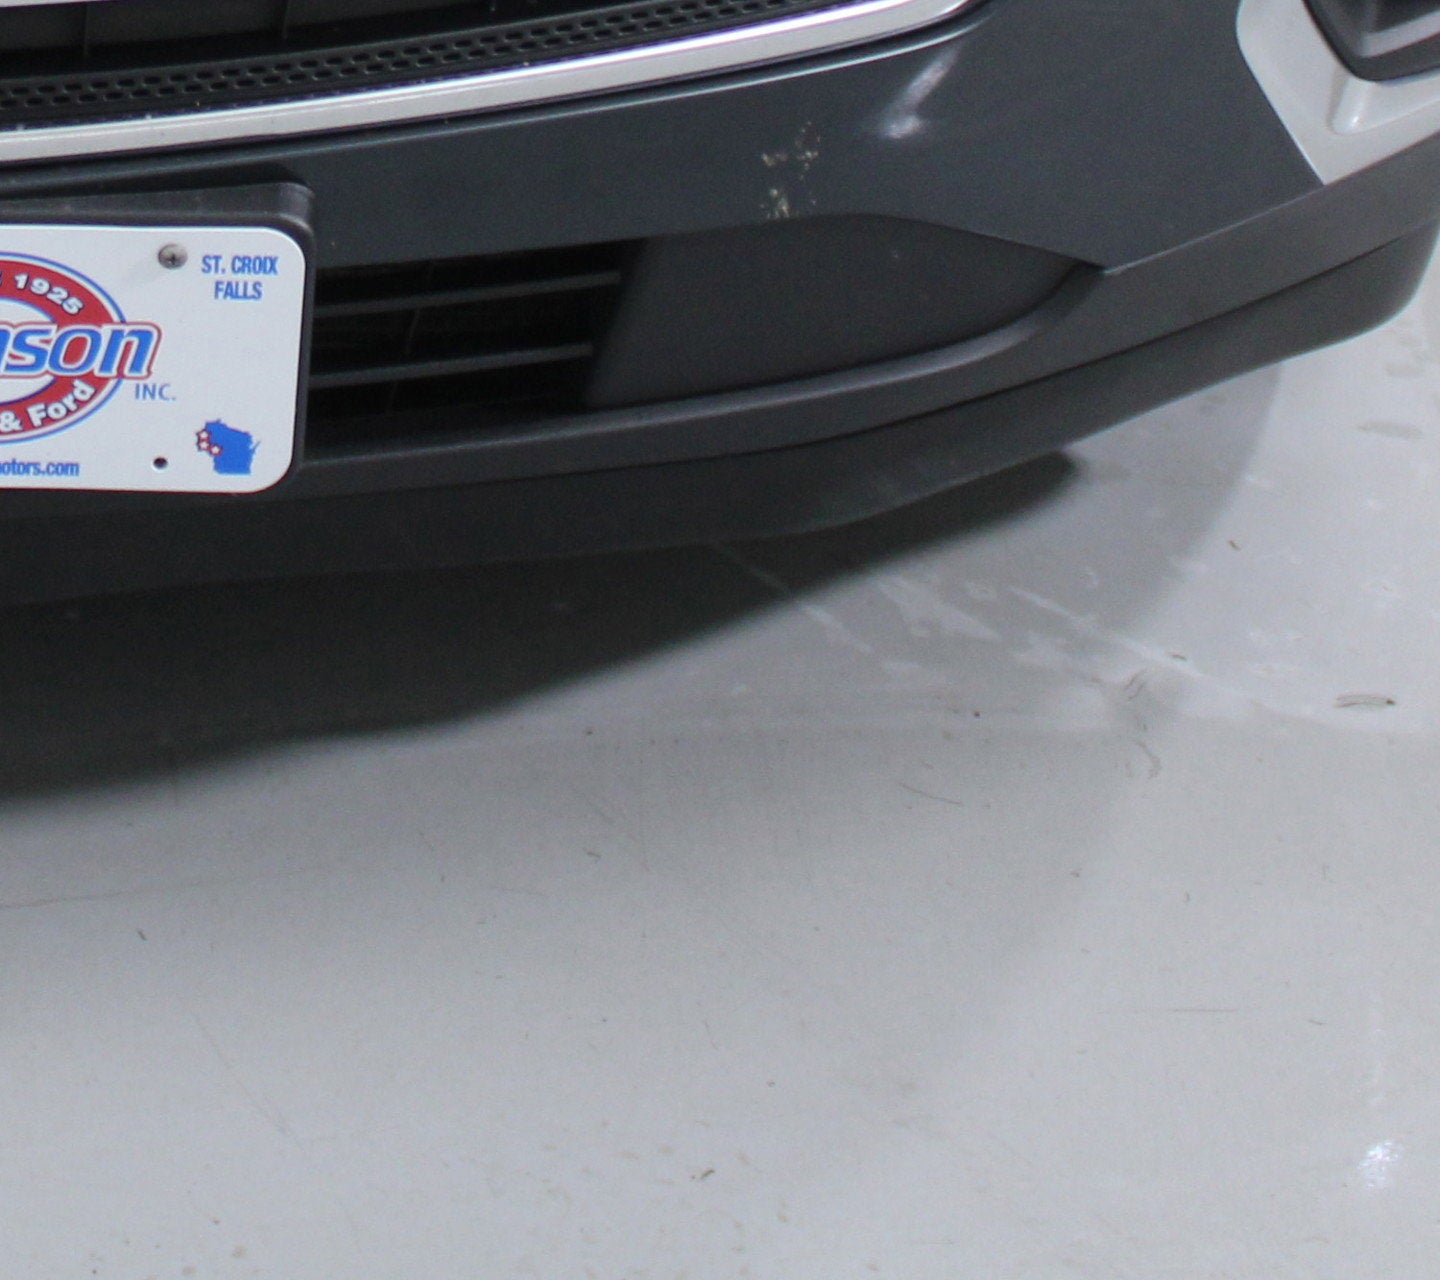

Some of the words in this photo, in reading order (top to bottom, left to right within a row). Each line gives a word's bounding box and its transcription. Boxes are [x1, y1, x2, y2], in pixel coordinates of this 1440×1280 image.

[201, 255, 226, 275] ST.
[231, 256, 278, 276] CROIX
[14, 273, 83, 316] 1925
[214, 281, 262, 300] FALLS
[134, 383, 176, 401] INC.
[28, 380, 93, 430] Ford
